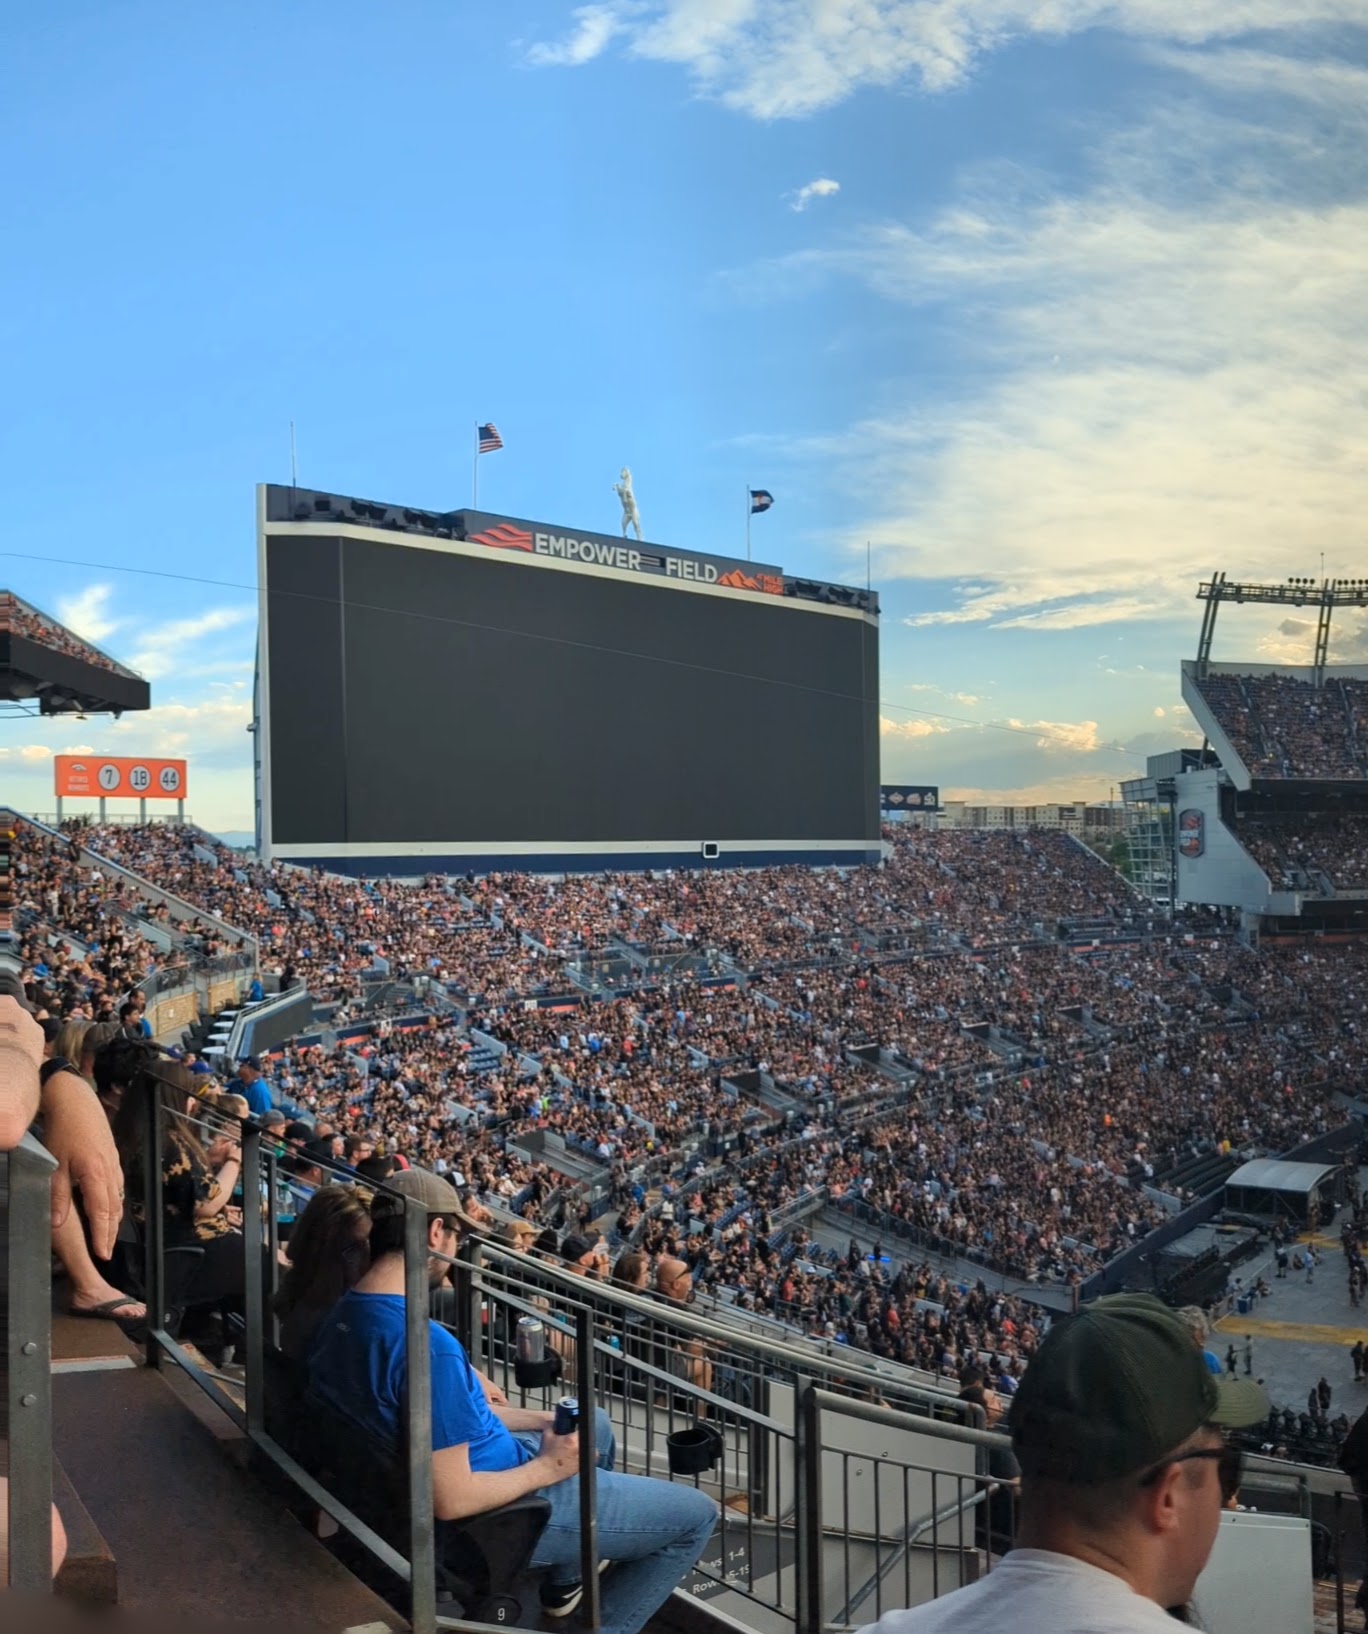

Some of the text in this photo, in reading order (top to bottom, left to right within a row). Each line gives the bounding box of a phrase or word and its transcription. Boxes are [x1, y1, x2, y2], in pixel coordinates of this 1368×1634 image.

[535, 533, 718, 584] EMPOWER FIELD
[105, 769, 113, 785] 7
[133, 770, 148, 786] 18
[162, 771, 177, 786] 44
[728, 1546, 746, 1561] 1-4
[692, 1580, 722, 1595] Row
[497, 1607, 506, 1621] 9
